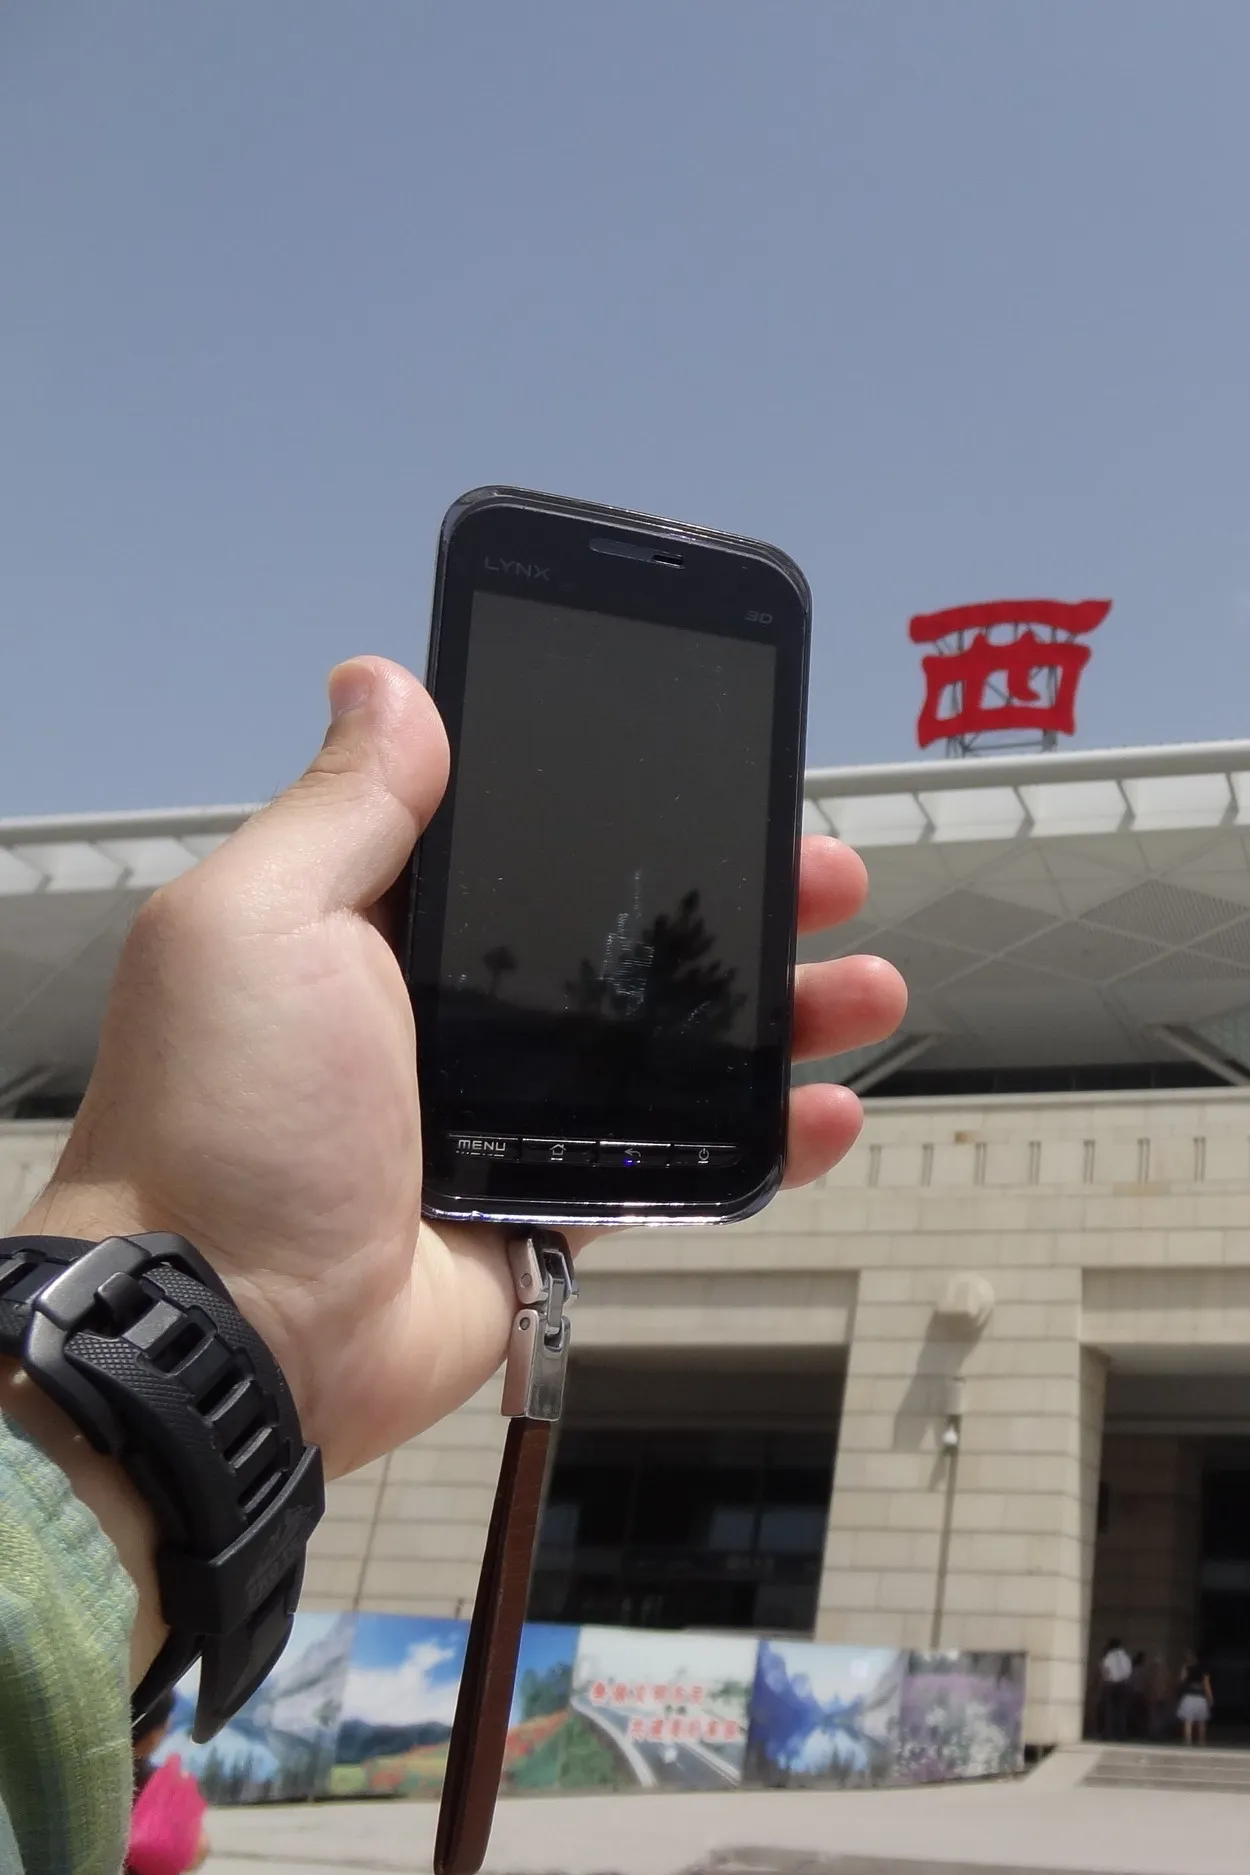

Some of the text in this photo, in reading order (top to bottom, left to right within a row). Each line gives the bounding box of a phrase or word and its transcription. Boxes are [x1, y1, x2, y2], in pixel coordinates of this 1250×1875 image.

[484, 555, 551, 582] LYNX
[743, 610, 773, 625] 3D
[458, 1139, 506, 1151] MENU
